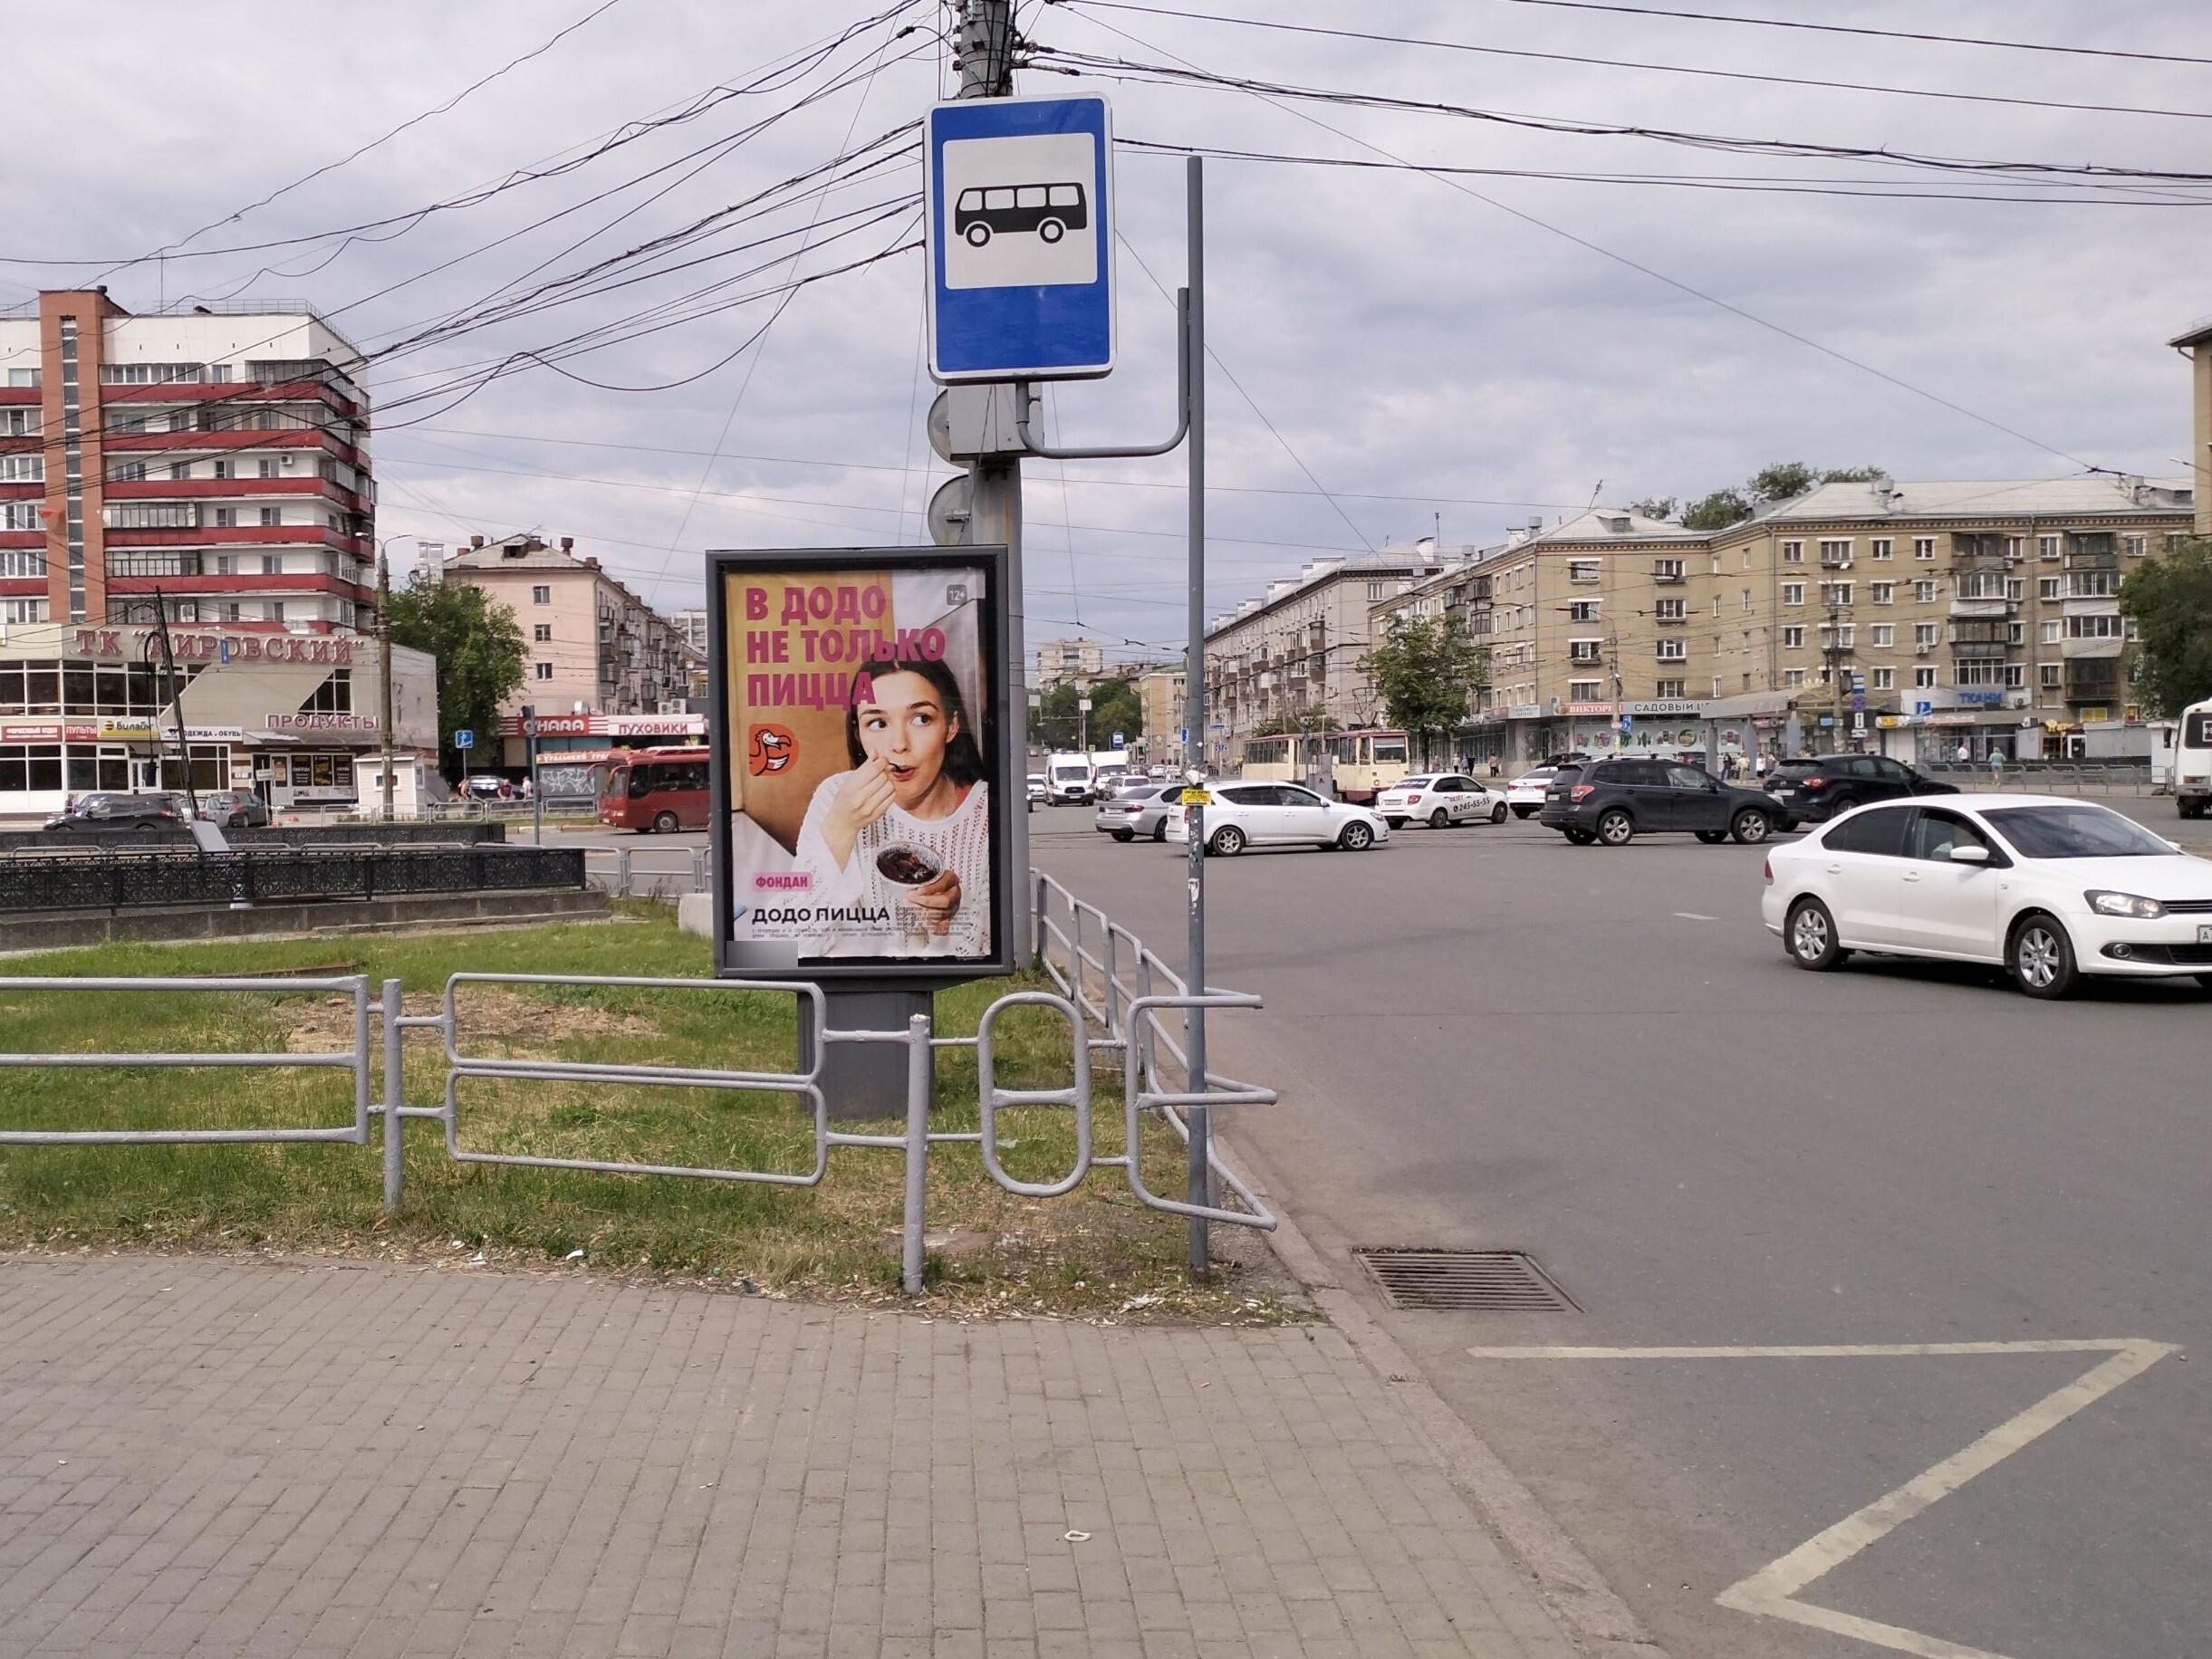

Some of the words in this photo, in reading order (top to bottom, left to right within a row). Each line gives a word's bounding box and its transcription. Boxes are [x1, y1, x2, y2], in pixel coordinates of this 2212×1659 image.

[948, 590, 966, 601] 12+
[746, 587, 768, 621] В
[781, 586, 886, 626] ДОДО
[74, 629, 123, 656] ТК
[746, 630, 789, 664] НЕ
[801, 628, 946, 663] ТОЛЬКО
[747, 671, 877, 712] ПИЦЦА
[1634, 702, 1695, 712] САДОВЫЙ
[65, 725, 97, 734] ПУЛЬТЫ
[116, 721, 151, 731] Билайн
[265, 714, 380, 730] ПРОДУКТЫ
[619, 724, 688, 734] ПУХОВИКИ
[1458, 797, 1490, 812] 245-55-55
[755, 876, 808, 889] ФОНДАН
[752, 907, 812, 925] ДОДО
[815, 906, 890, 923] ПИЦЦА
